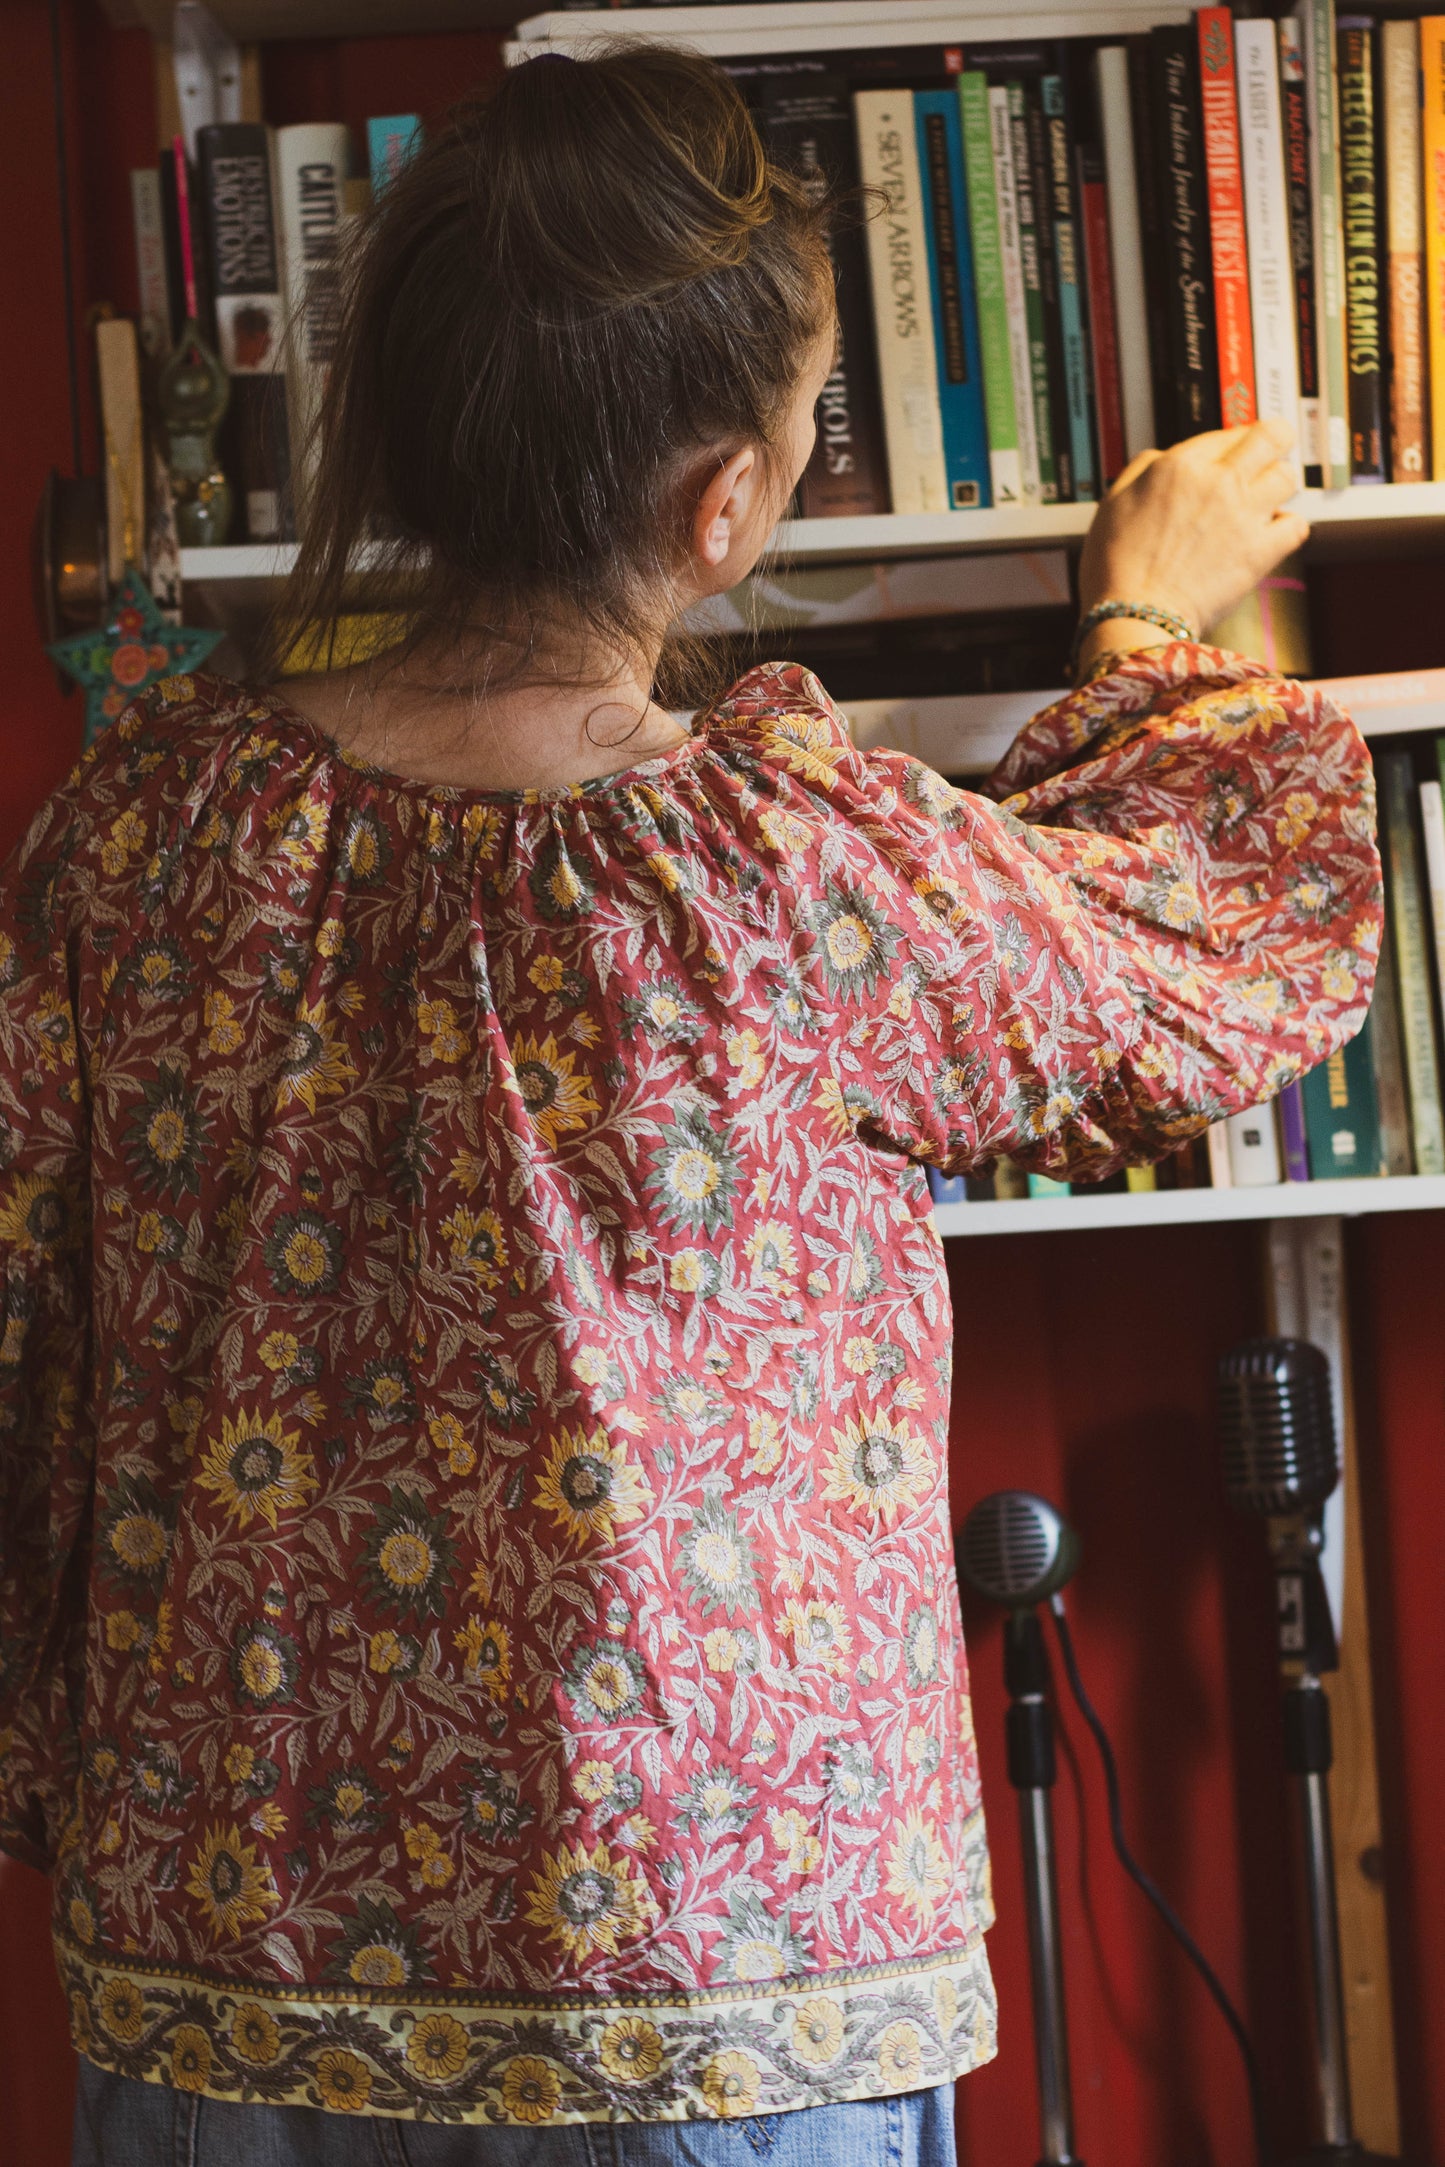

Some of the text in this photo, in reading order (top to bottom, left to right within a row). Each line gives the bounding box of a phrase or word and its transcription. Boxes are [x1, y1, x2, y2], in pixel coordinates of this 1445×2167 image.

[962, 86, 986, 136] THE
[1166, 53, 1186, 95] Fine
[1248, 70, 1270, 129] EASIEST
[880, 131, 906, 216] SEVEN
[968, 142, 992, 186] BEE
[1168, 103, 1194, 164] Indian
[1287, 93, 1307, 185] ANATOMY
[1394, 48, 1417, 240] PAUL HOLLYWOOD
[211, 157, 248, 285] EMOTIONS
[299, 164, 339, 260] CAITLIN
[1170, 166, 1198, 233] Jewelry
[1342, 72, 1381, 375] ELECTRIC KILN CERAMICS
[887, 220, 919, 339] ARROWS
[973, 191, 1001, 301] GARDEN
[1398, 261, 1422, 304] 100
[1178, 274, 1206, 371] Southwest
